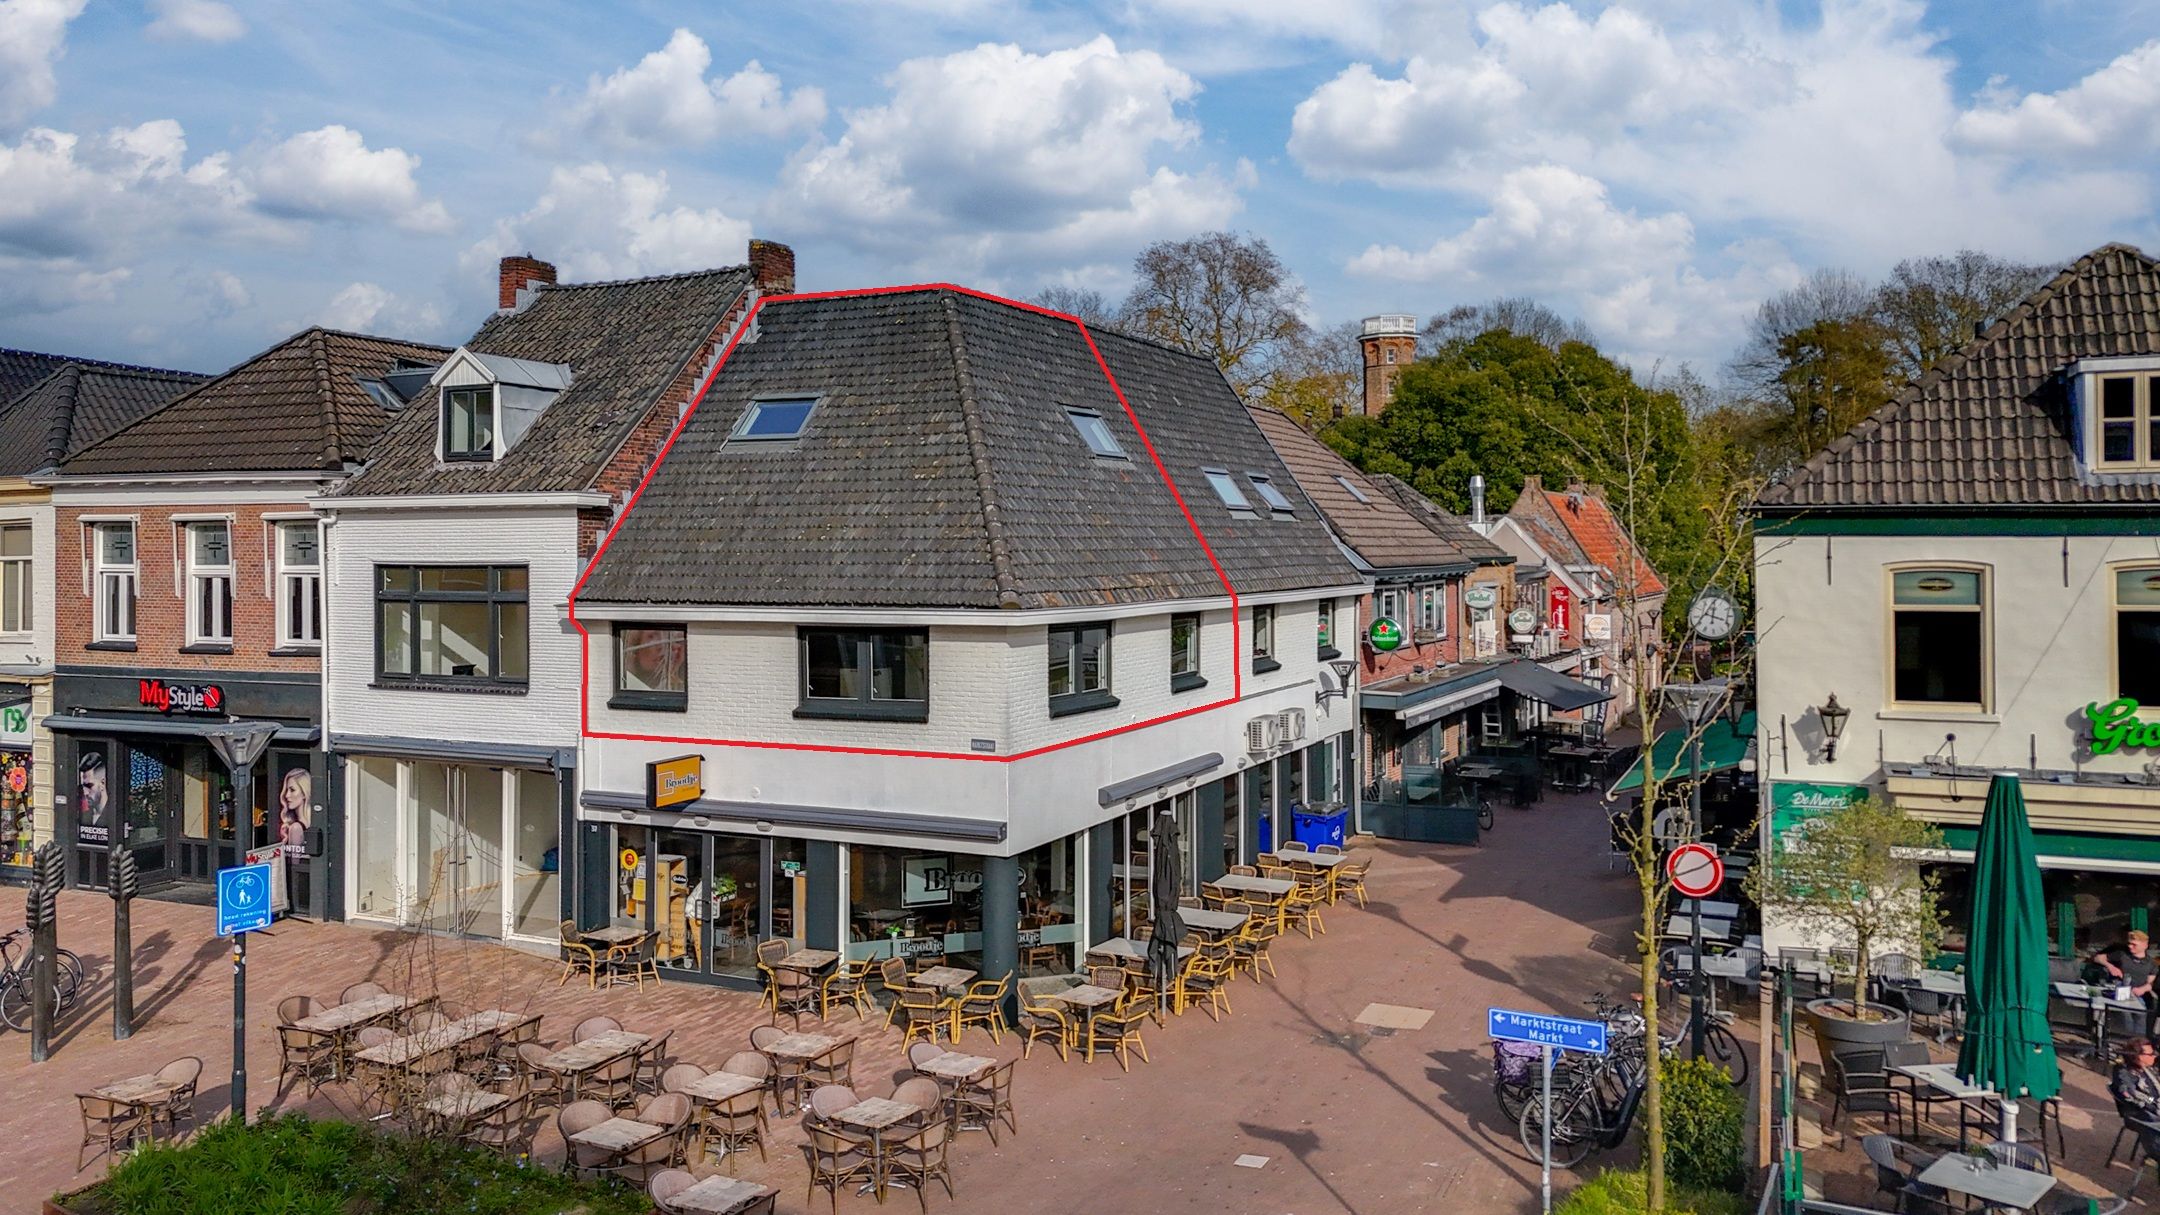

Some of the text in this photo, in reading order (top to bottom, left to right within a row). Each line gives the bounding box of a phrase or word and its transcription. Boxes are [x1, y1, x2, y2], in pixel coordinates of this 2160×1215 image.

[140, 680, 204, 711] MyStyle
[80, 825, 109, 835] PRECISIE
[1510, 1015, 1582, 1035] Marktstraat
[1529, 1030, 1564, 1043] Markt
